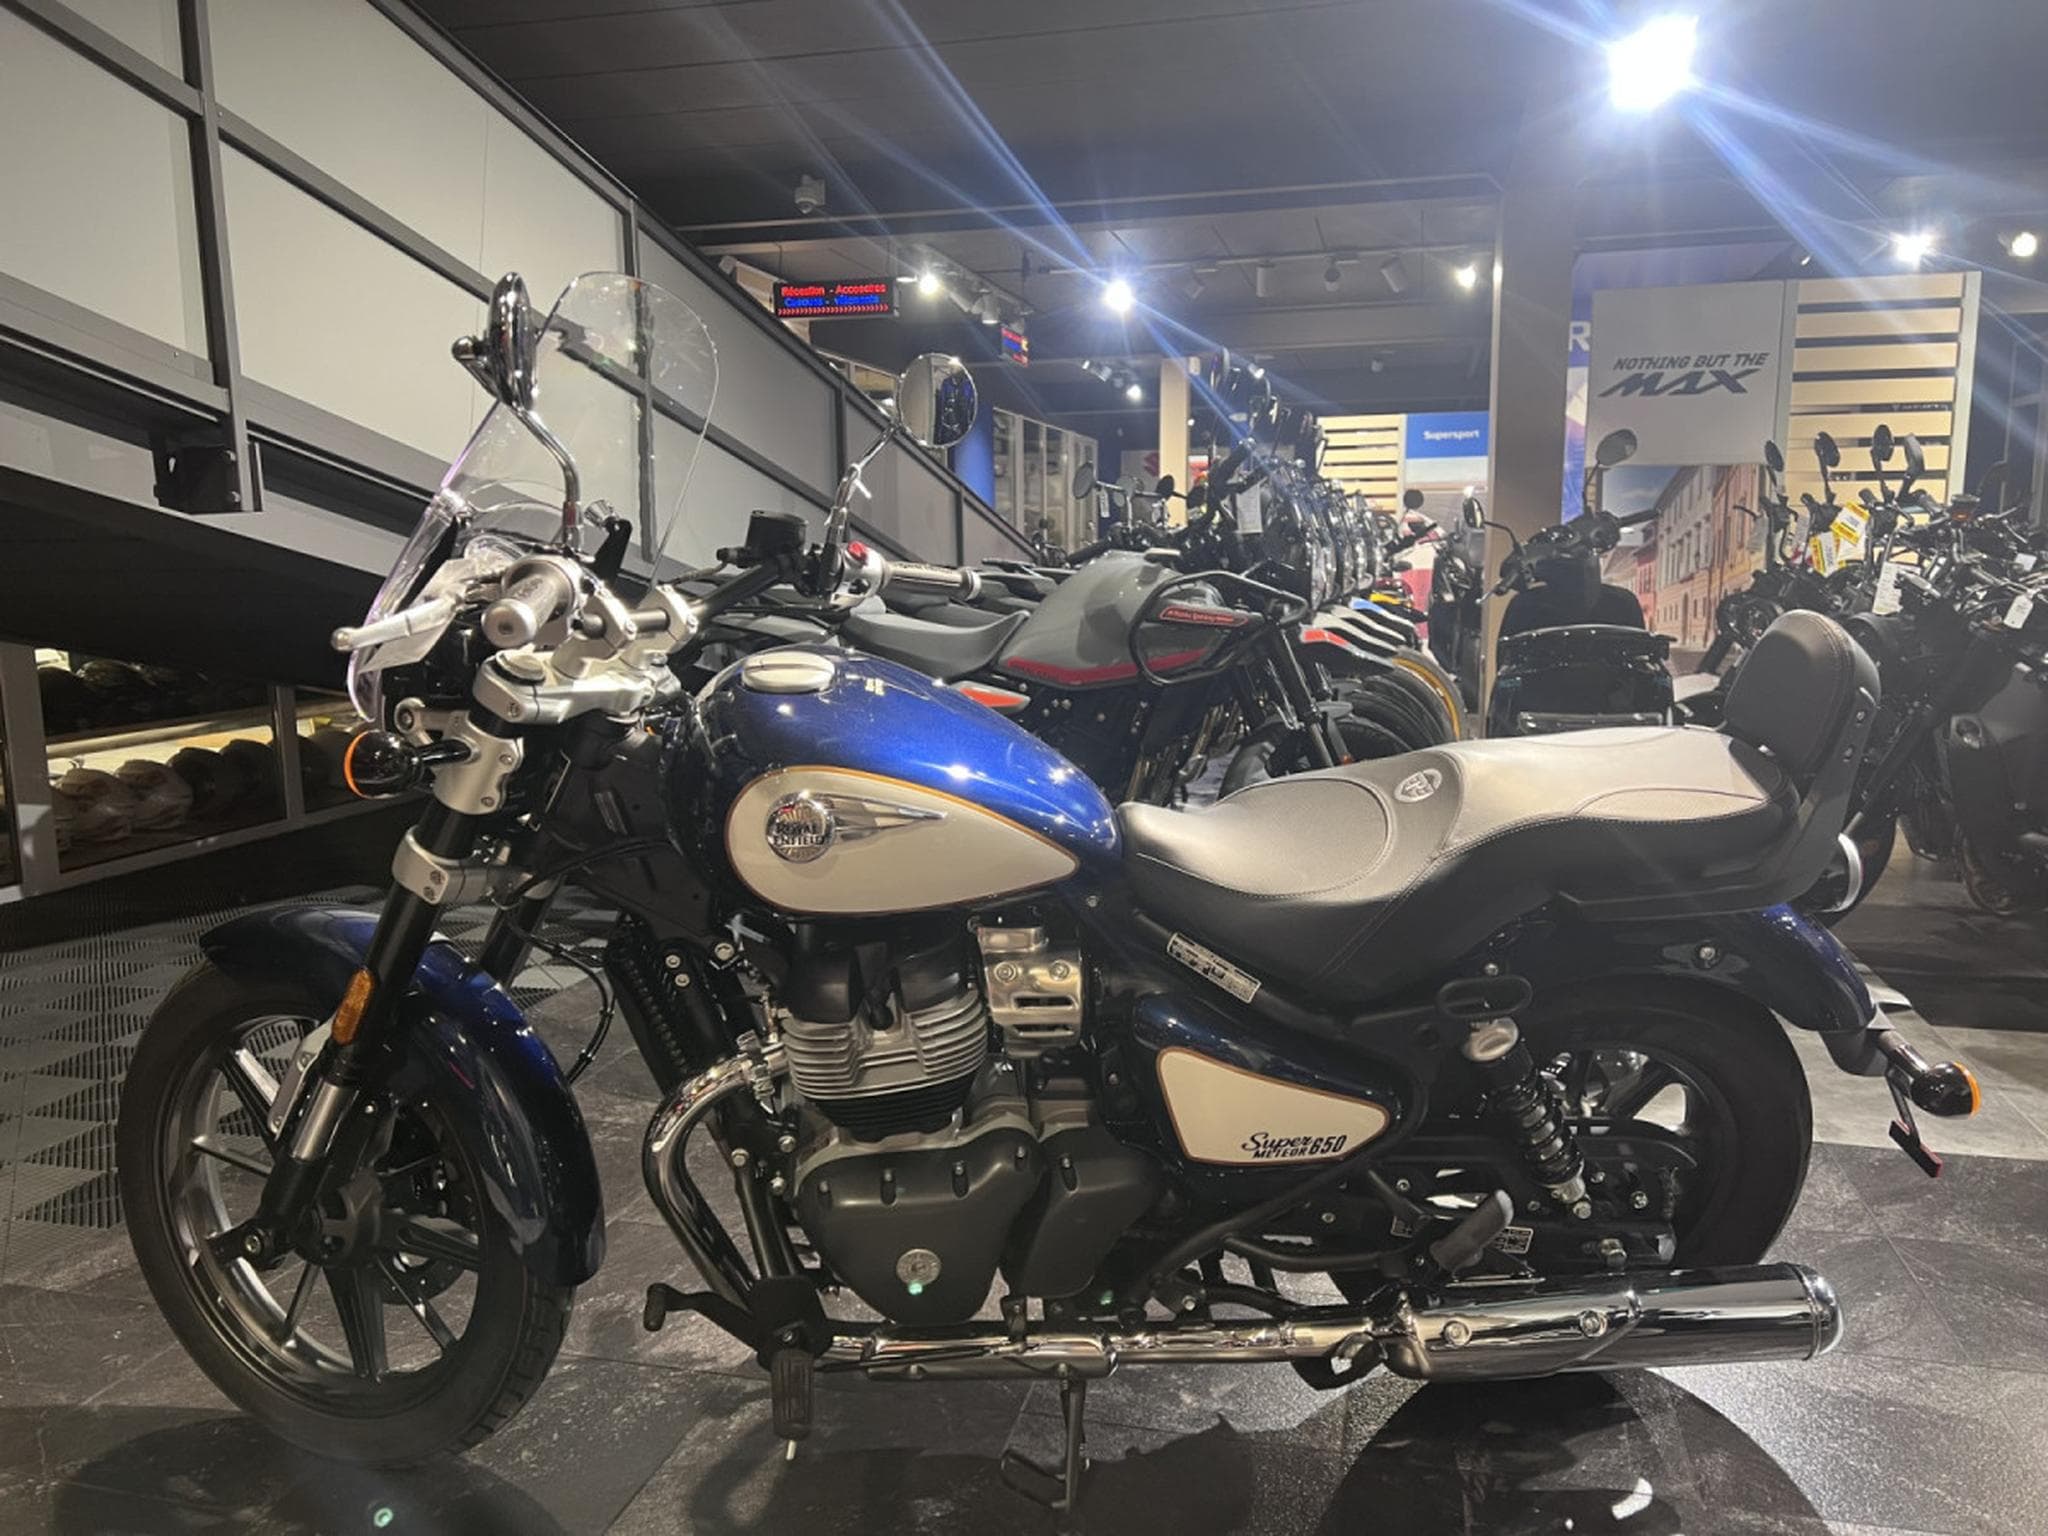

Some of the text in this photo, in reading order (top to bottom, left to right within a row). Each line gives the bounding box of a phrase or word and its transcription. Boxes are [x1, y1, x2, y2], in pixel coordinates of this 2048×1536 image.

[1613, 352, 1771, 370] NOTHING BUT THE
[1598, 368, 1761, 397] MAX
[1423, 429, 1480, 441] Supersport
[1241, 1132, 1312, 1152] Super
[1308, 1135, 1347, 1155] 650
[1252, 1146, 1309, 1159] METEOR
